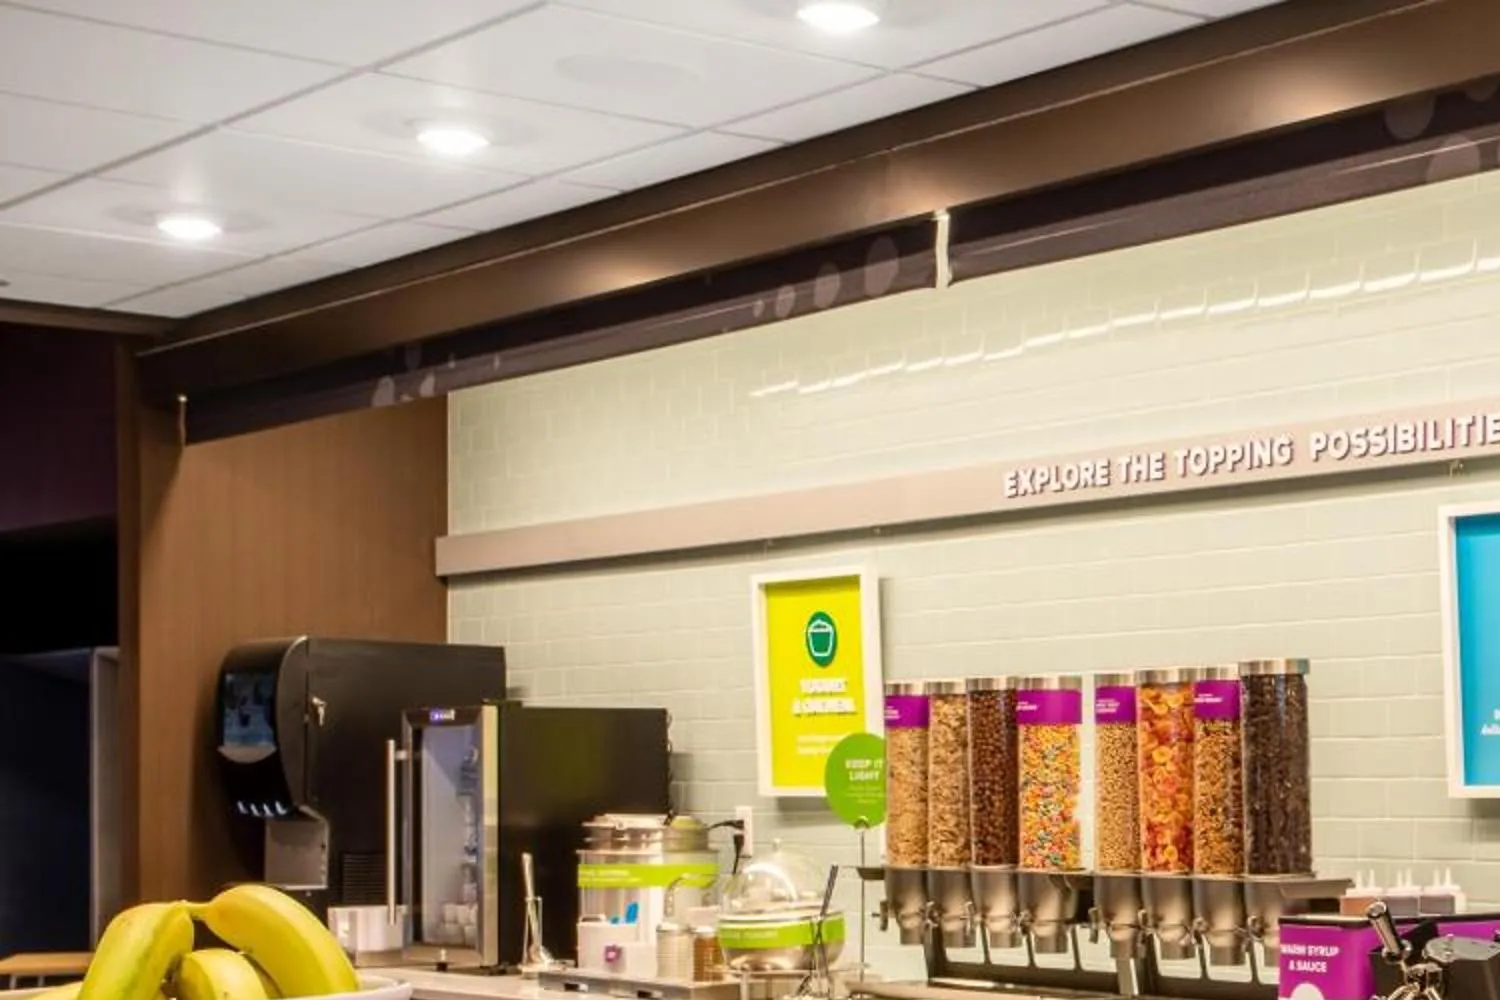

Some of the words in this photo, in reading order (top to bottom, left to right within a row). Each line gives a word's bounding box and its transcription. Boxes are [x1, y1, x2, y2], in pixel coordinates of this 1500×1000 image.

[1002, 457, 1112, 499] EXPLORE
[1117, 451, 1167, 484] THE
[1174, 433, 1295, 478] TOPPING
